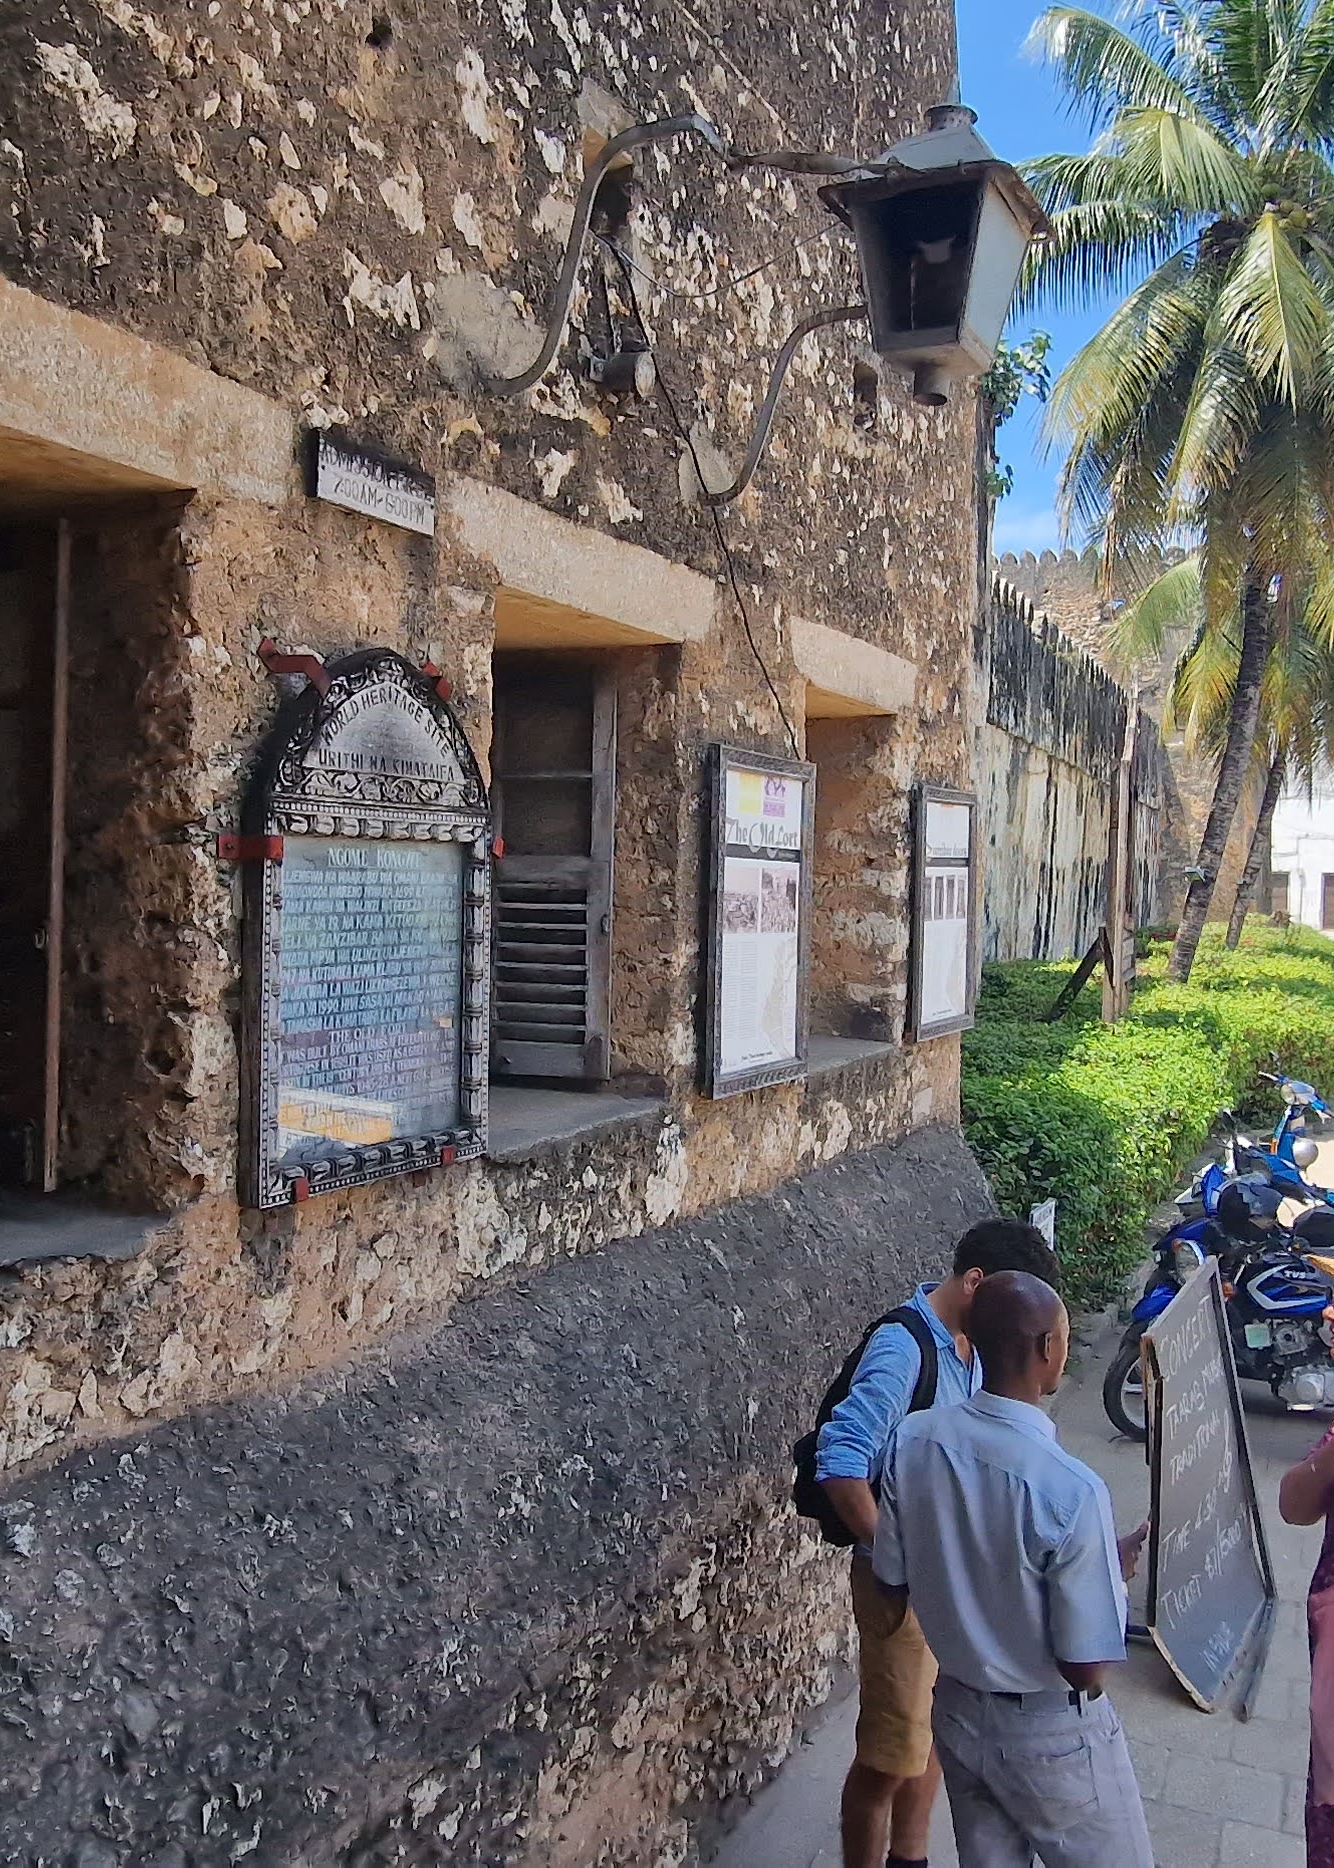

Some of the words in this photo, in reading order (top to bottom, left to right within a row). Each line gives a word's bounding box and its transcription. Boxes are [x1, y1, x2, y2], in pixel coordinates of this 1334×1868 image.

[321, 700, 359, 746] WORLD
[361, 685, 423, 723] HERITAGE
[425, 719, 449, 758] SITE
[319, 748, 363, 769] URITHI
[393, 760, 454, 781] KIMATAIFA
[748, 821, 776, 854] Old
[328, 847, 368, 869] NGOME
[320, 930, 367, 948] ZANZIBAR
[318, 998, 338, 1014] 1990
[328, 1029, 350, 1043] THE
[354, 1025, 374, 1040] OLD
[381, 1021, 406, 1036] FORT
[1159, 1294, 1212, 1383] CONCERT
